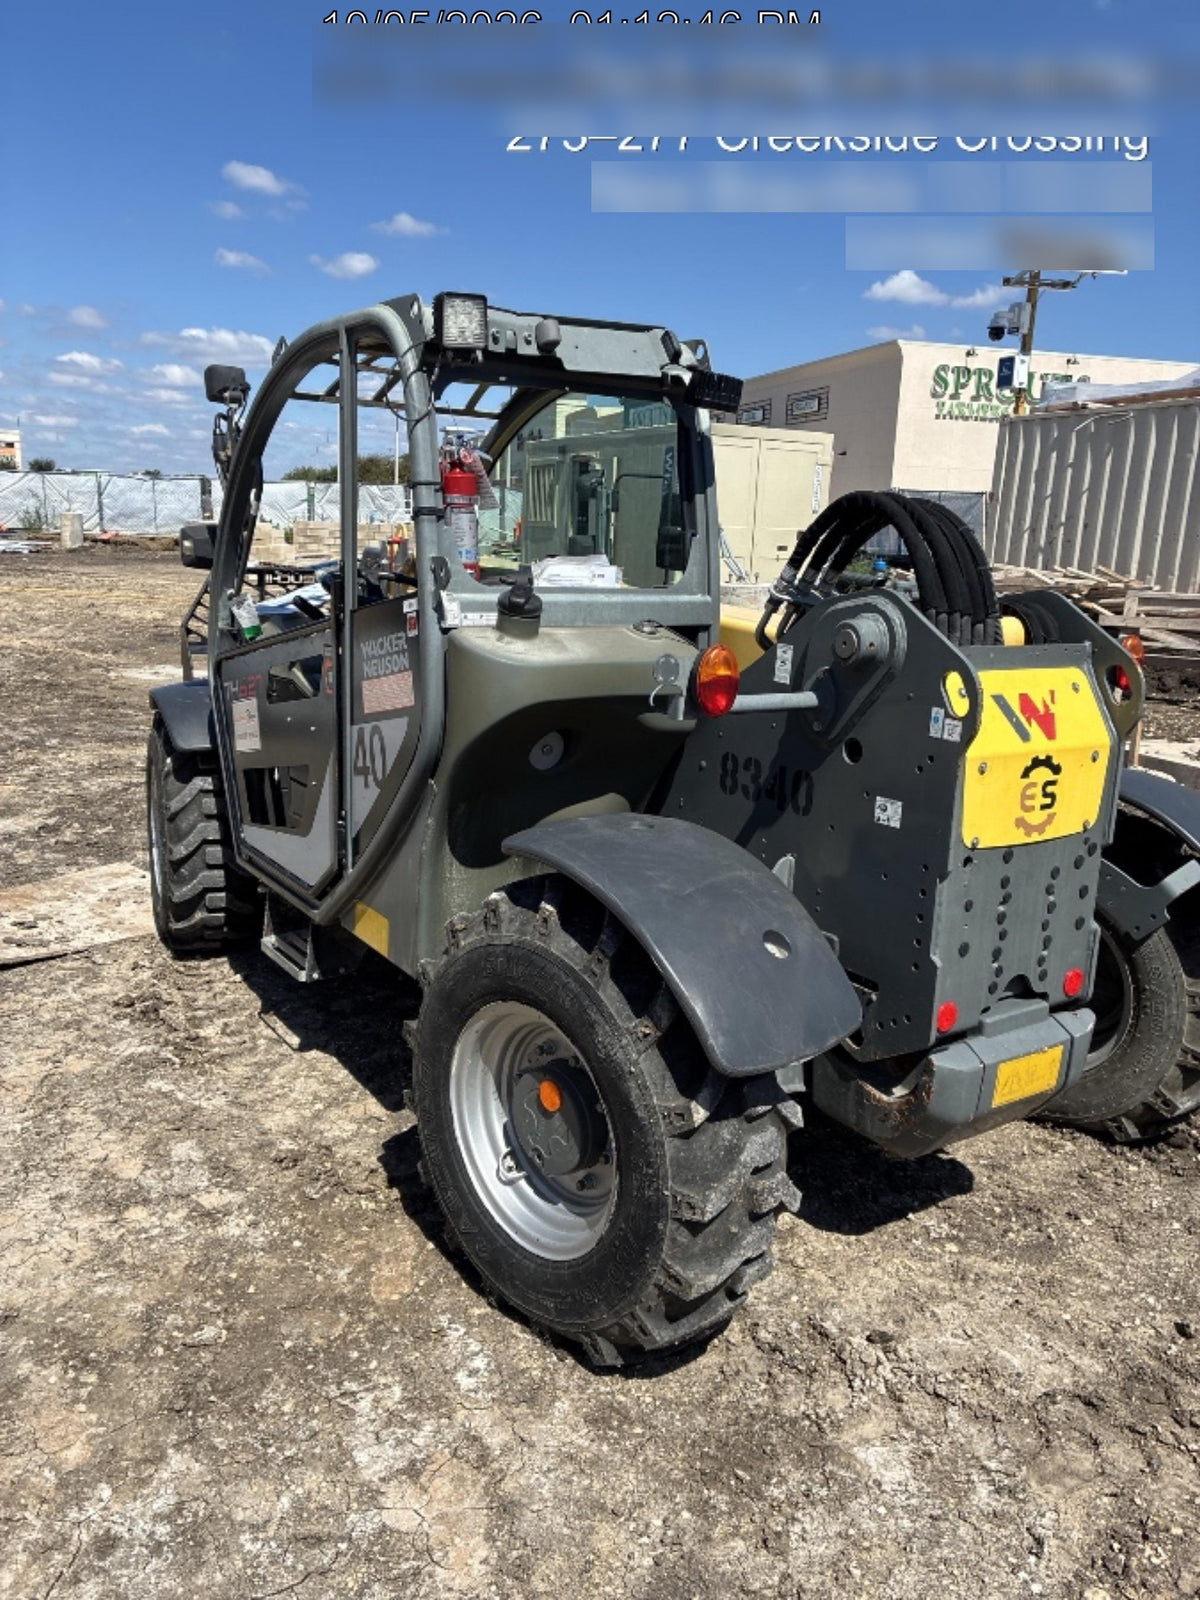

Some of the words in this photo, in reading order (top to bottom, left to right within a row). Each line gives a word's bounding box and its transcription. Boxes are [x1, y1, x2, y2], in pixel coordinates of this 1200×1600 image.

[930, 364, 1091, 405] SPRU
[360, 631, 408, 660] WACKER
[363, 651, 410, 678] NEUSON
[353, 724, 387, 791] 40
[719, 750, 815, 818] 8340
[1020, 779, 1058, 813] ES
